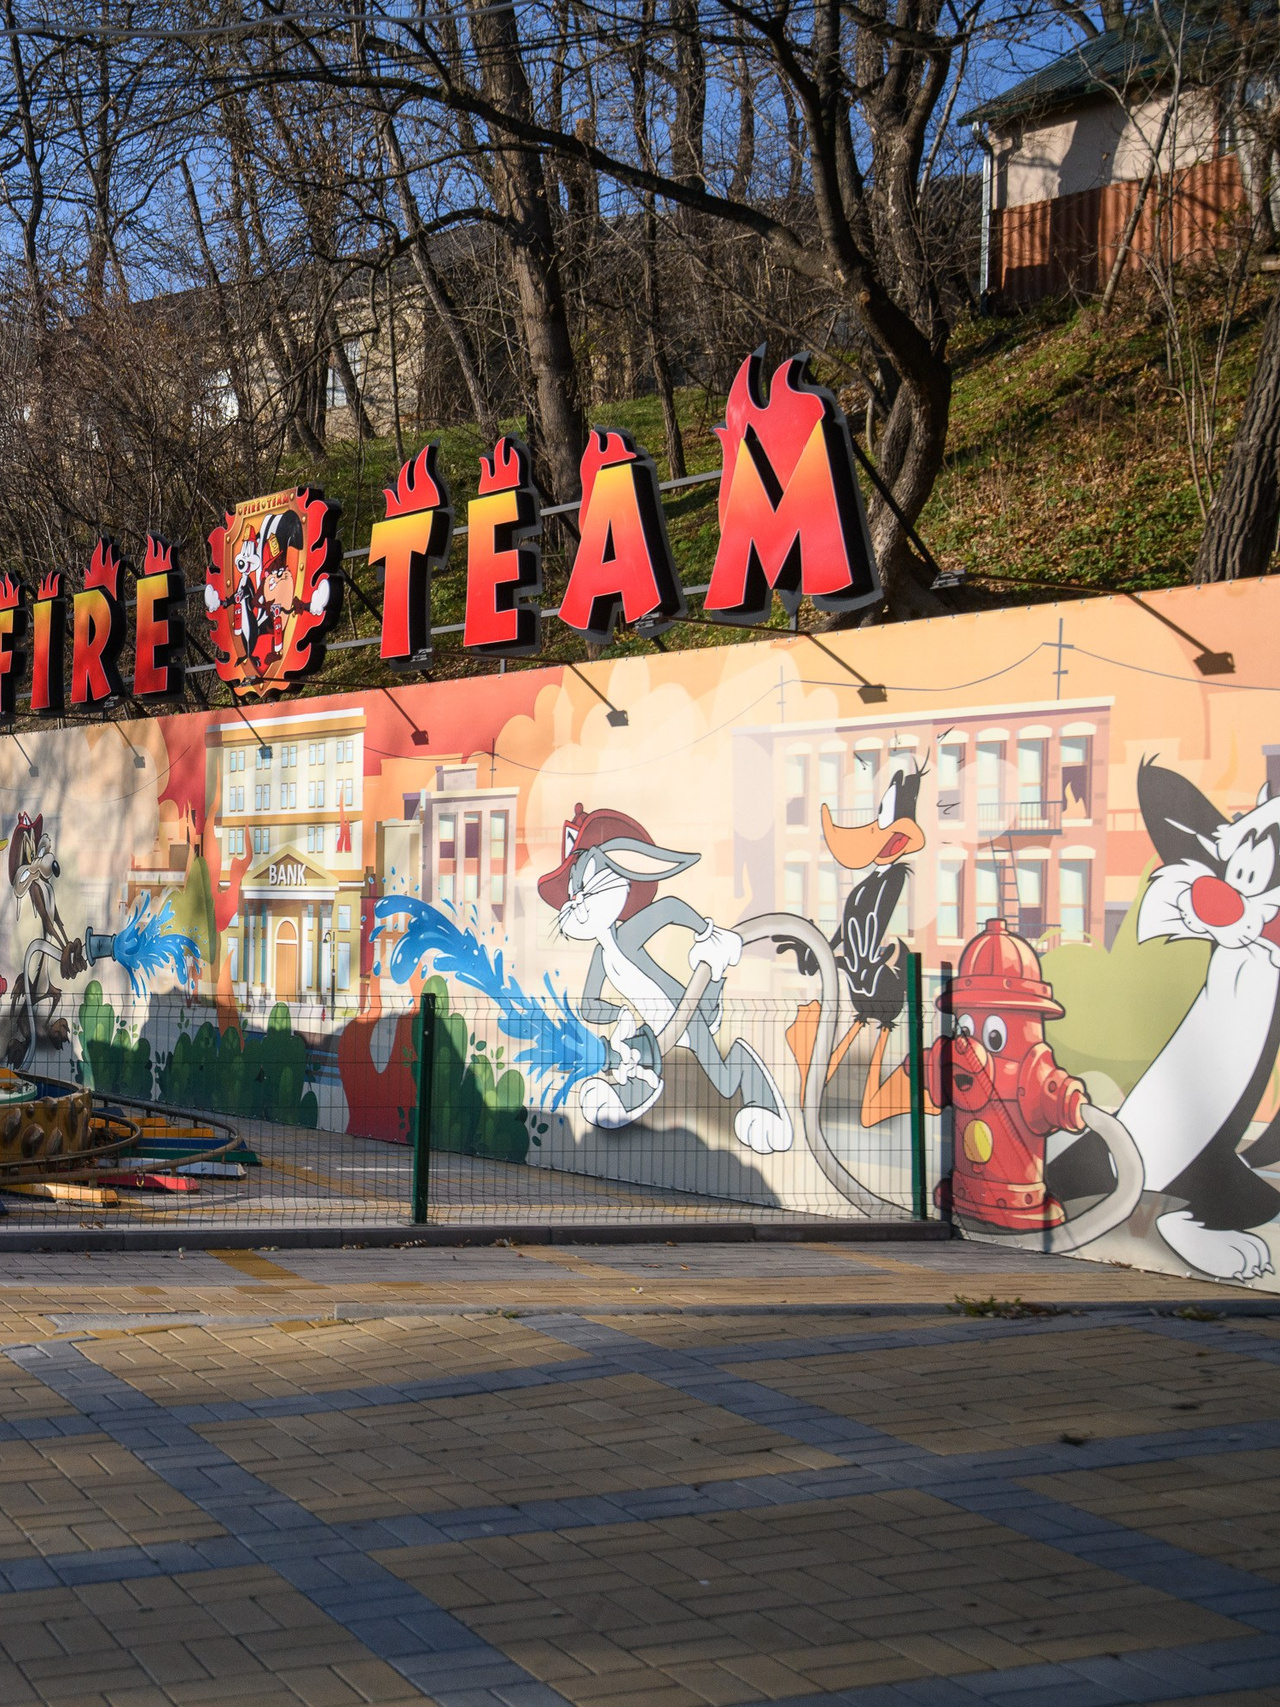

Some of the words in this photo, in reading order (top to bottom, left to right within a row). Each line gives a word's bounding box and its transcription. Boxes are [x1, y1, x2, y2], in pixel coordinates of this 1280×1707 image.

[243, 501, 260, 516] FIRE
[266, 496, 290, 508] TEAM
[368, 355, 854, 660] TEAM
[269, 864, 307, 886] BANK
